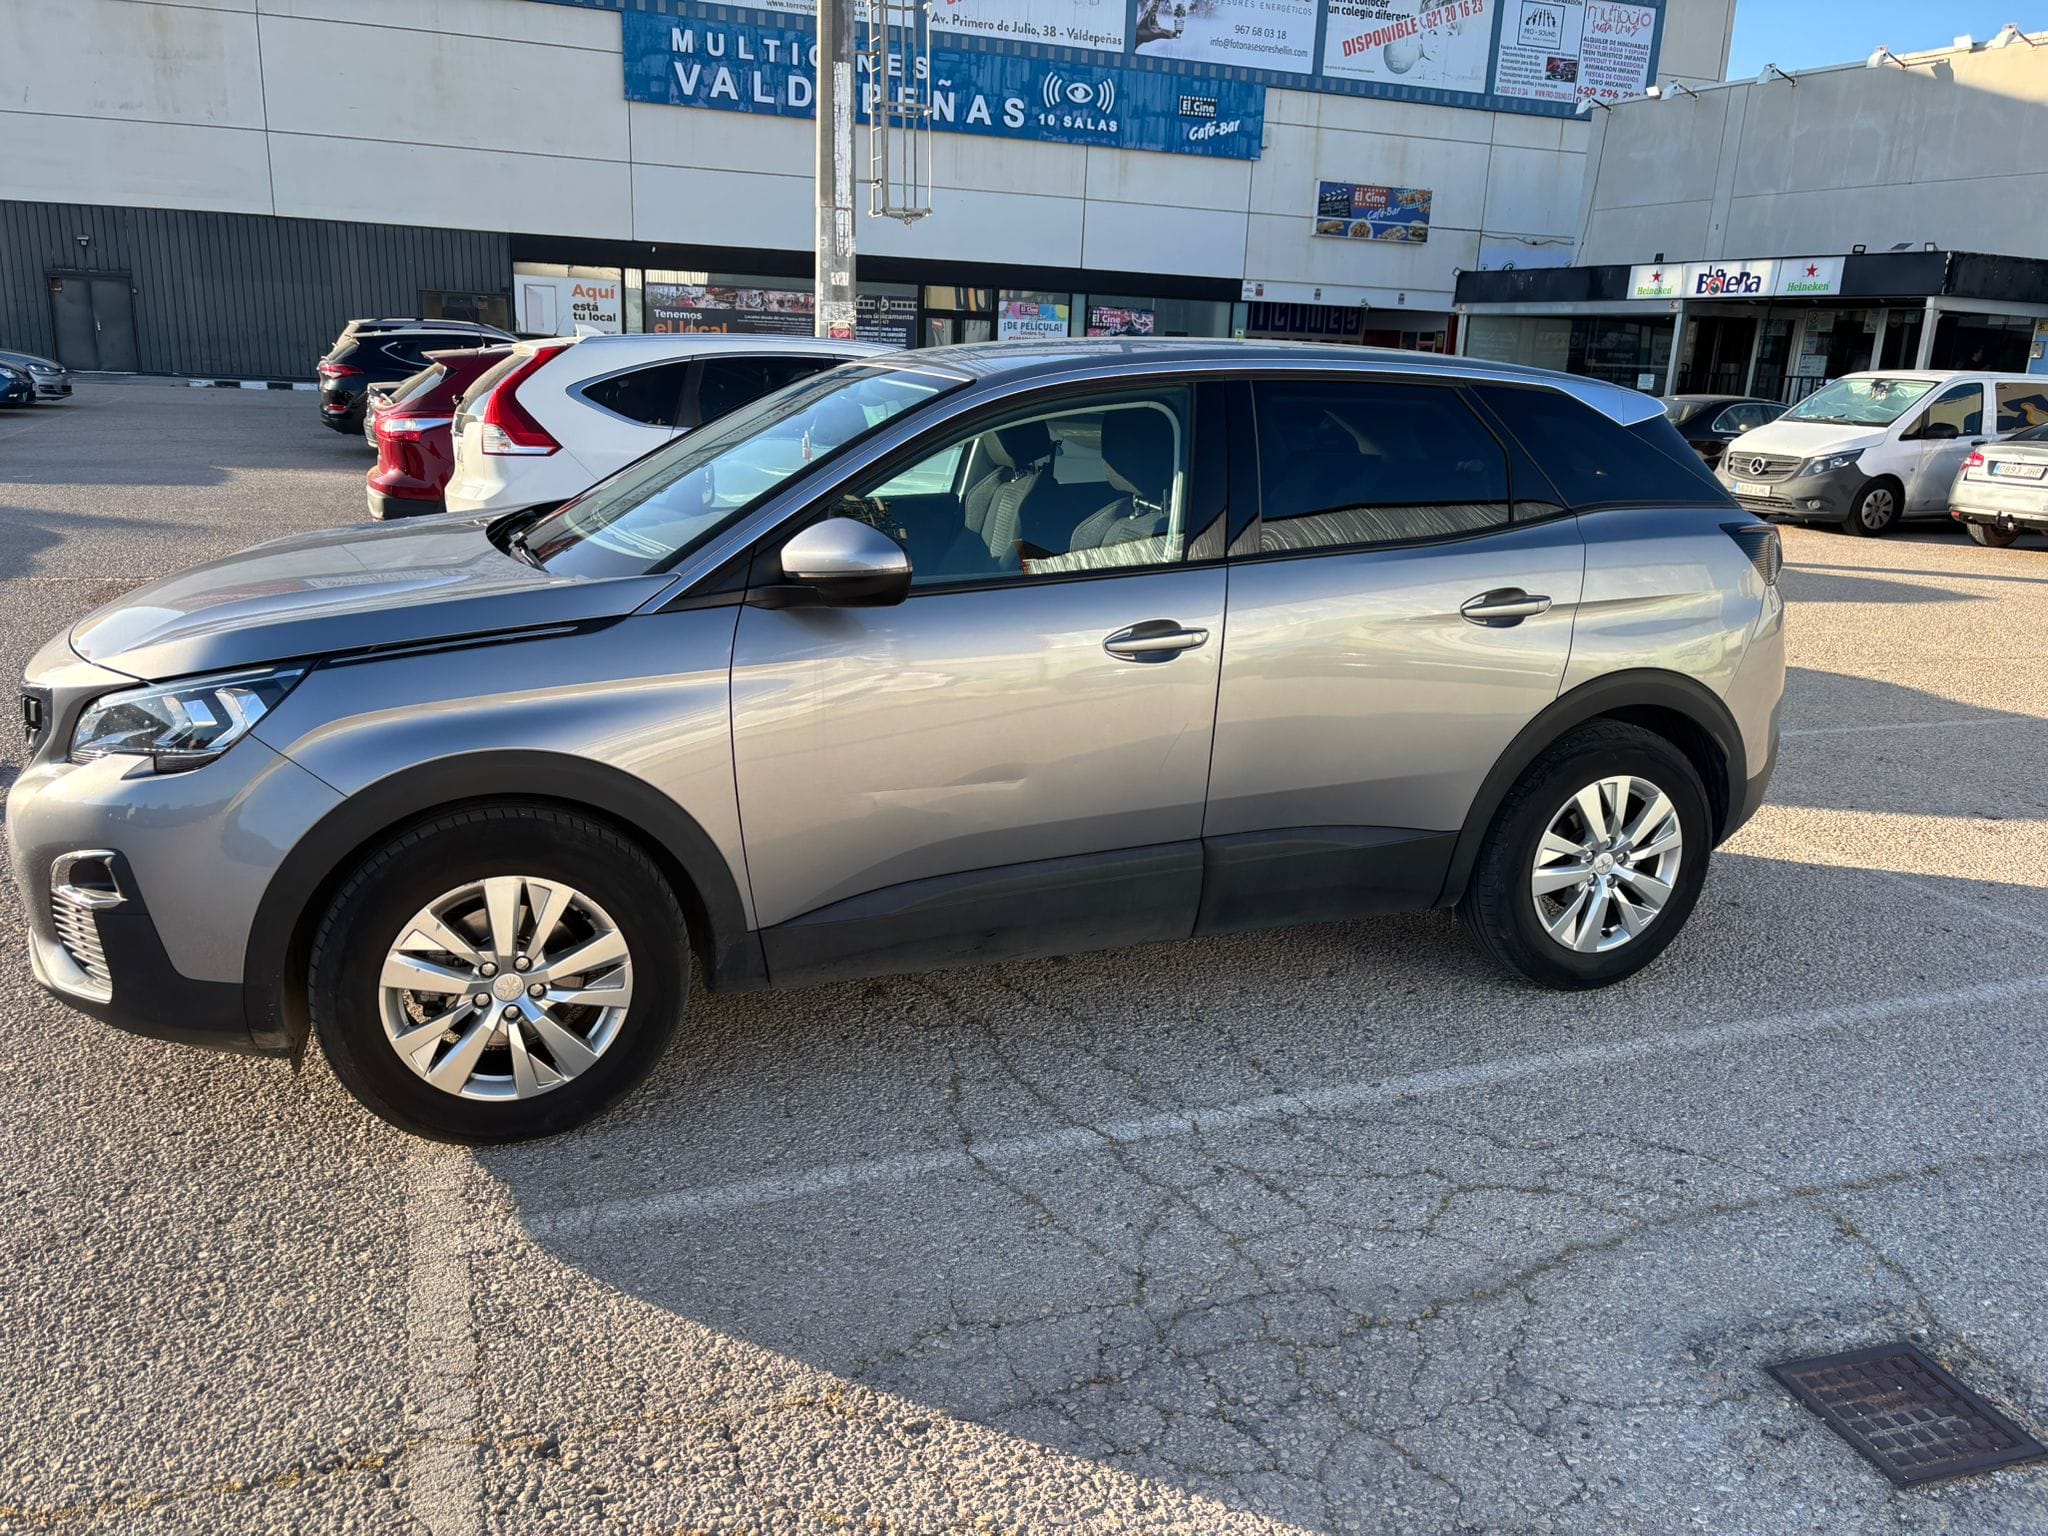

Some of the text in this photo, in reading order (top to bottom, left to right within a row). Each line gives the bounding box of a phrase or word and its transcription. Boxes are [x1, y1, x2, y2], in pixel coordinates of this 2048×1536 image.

[1328, 6, 1340, 14] un
[1341, 6, 1373, 19] colegio
[931, 11, 949, 24] Av.
[952, 14, 994, 30] Primero
[997, 20, 1010, 32] de
[1012, 21, 1040, 38] Julio,
[1043, 25, 1057, 37] 38
[1066, 27, 1122, 46] Valdepeñas
[1234, 24, 1287, 39] 967 68 03 18
[1343, 0, 1483, 57] DISPONIBLE 621 20 16 23
[1584, 36, 1608, 45] ALQUILER
[1617, 40, 1649, 51] HINCHABLES
[671, 27, 928, 80] MULTICNES
[1589, 78, 1603, 86] TORO
[674, 62, 1026, 128] VALDPEÑAS
[1577, 86, 1597, 96] 620
[1600, 88, 1619, 99] 296
[1182, 100, 1215, 113] El Cine
[1039, 112, 1118, 133] 10 SALAS
[1189, 119, 1240, 141] Café-Bar
[1355, 191, 1386, 204] El Cine
[1367, 207, 1401, 220] Café-Bar
[572, 283, 617, 301] Aquí
[1637, 285, 1672, 297] Heineken
[1787, 281, 1829, 293] Heineken
[573, 302, 599, 312] está
[573, 312, 616, 322] tu local
[654, 309, 703, 320] Tenemos
[1092, 313, 1121, 324] El Cine
[654, 320, 672, 334] el
[680, 320, 728, 334] local
[1003, 320, 1063, 332] ¡DE PELÍCULA!
